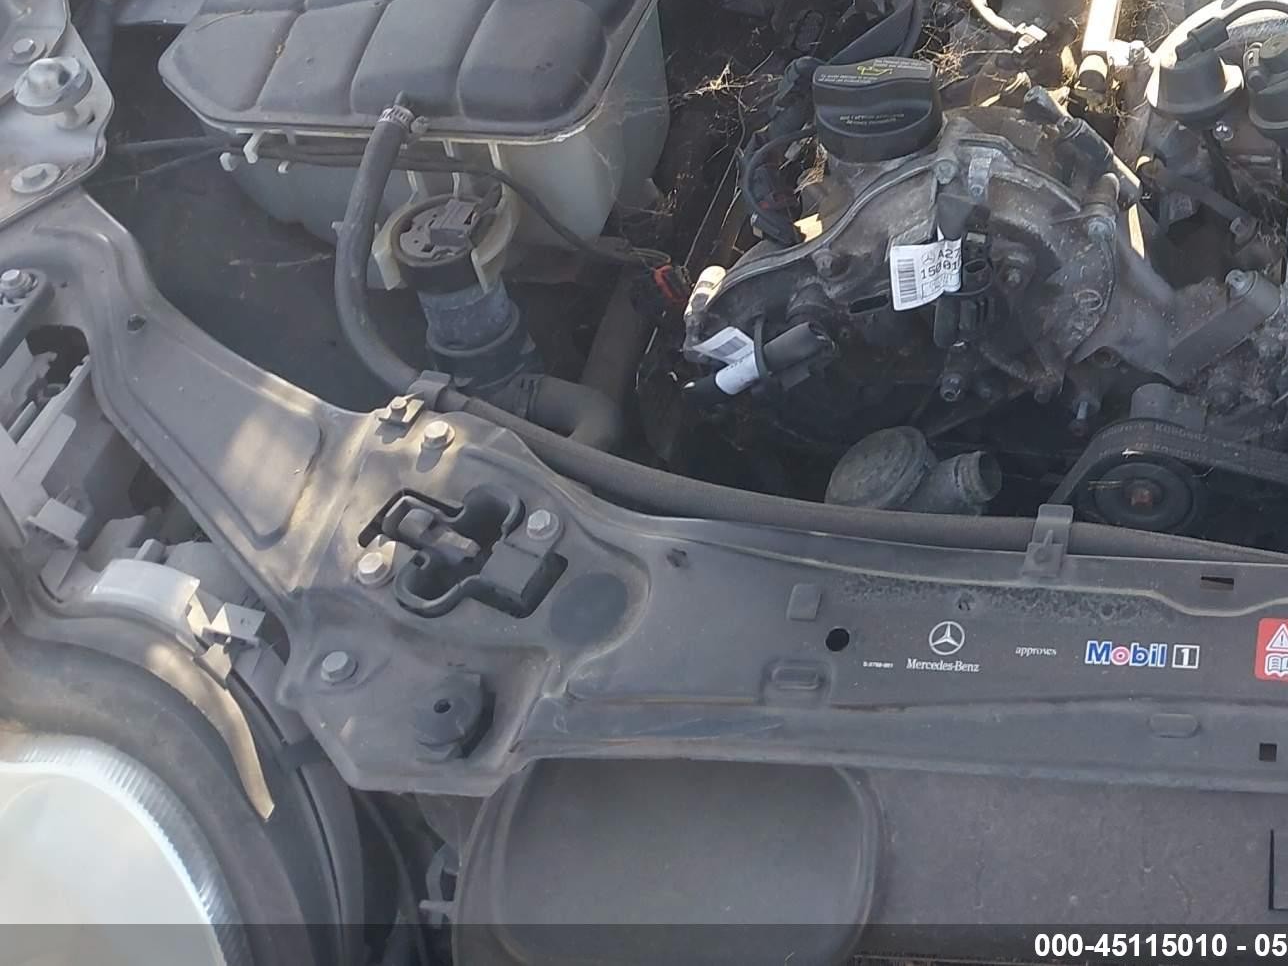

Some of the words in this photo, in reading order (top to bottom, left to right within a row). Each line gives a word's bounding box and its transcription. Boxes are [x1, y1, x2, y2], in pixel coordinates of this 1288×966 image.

[1015, 645, 1057, 657] approves
[1085, 640, 1168, 667] Mobil
[906, 658, 980, 673] Mercedes-Benz
